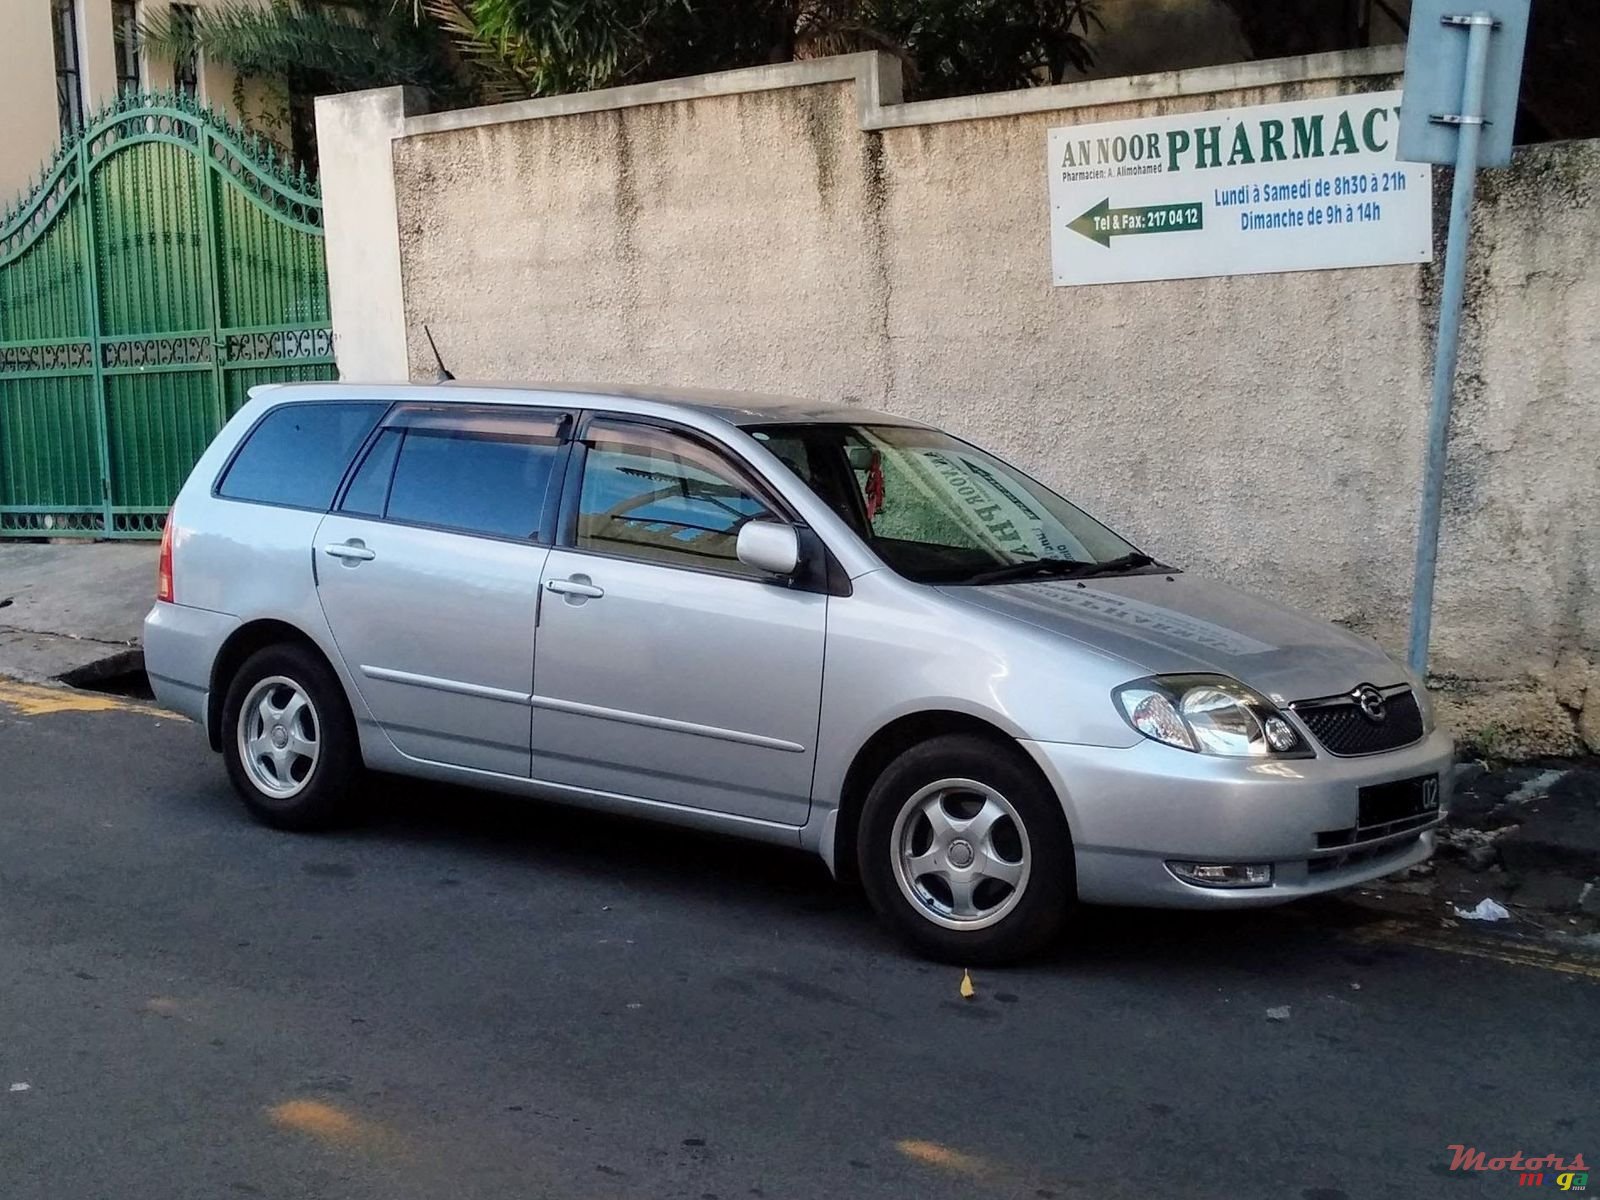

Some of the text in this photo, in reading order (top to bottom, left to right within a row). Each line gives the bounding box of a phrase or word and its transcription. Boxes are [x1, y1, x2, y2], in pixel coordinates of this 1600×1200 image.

[1061, 106, 1401, 172] AN NOOR PHARMAC
[1116, 163, 1162, 177] Alimohamed
[1215, 171, 1406, 207] Lundi à Samedi de 8h30 à 21h
[1094, 208, 1198, 231] Tel & Fax: 217 04 12
[1241, 202, 1381, 231] Dimanche de 9h à 14h
[1422, 777, 1438, 810] 02
